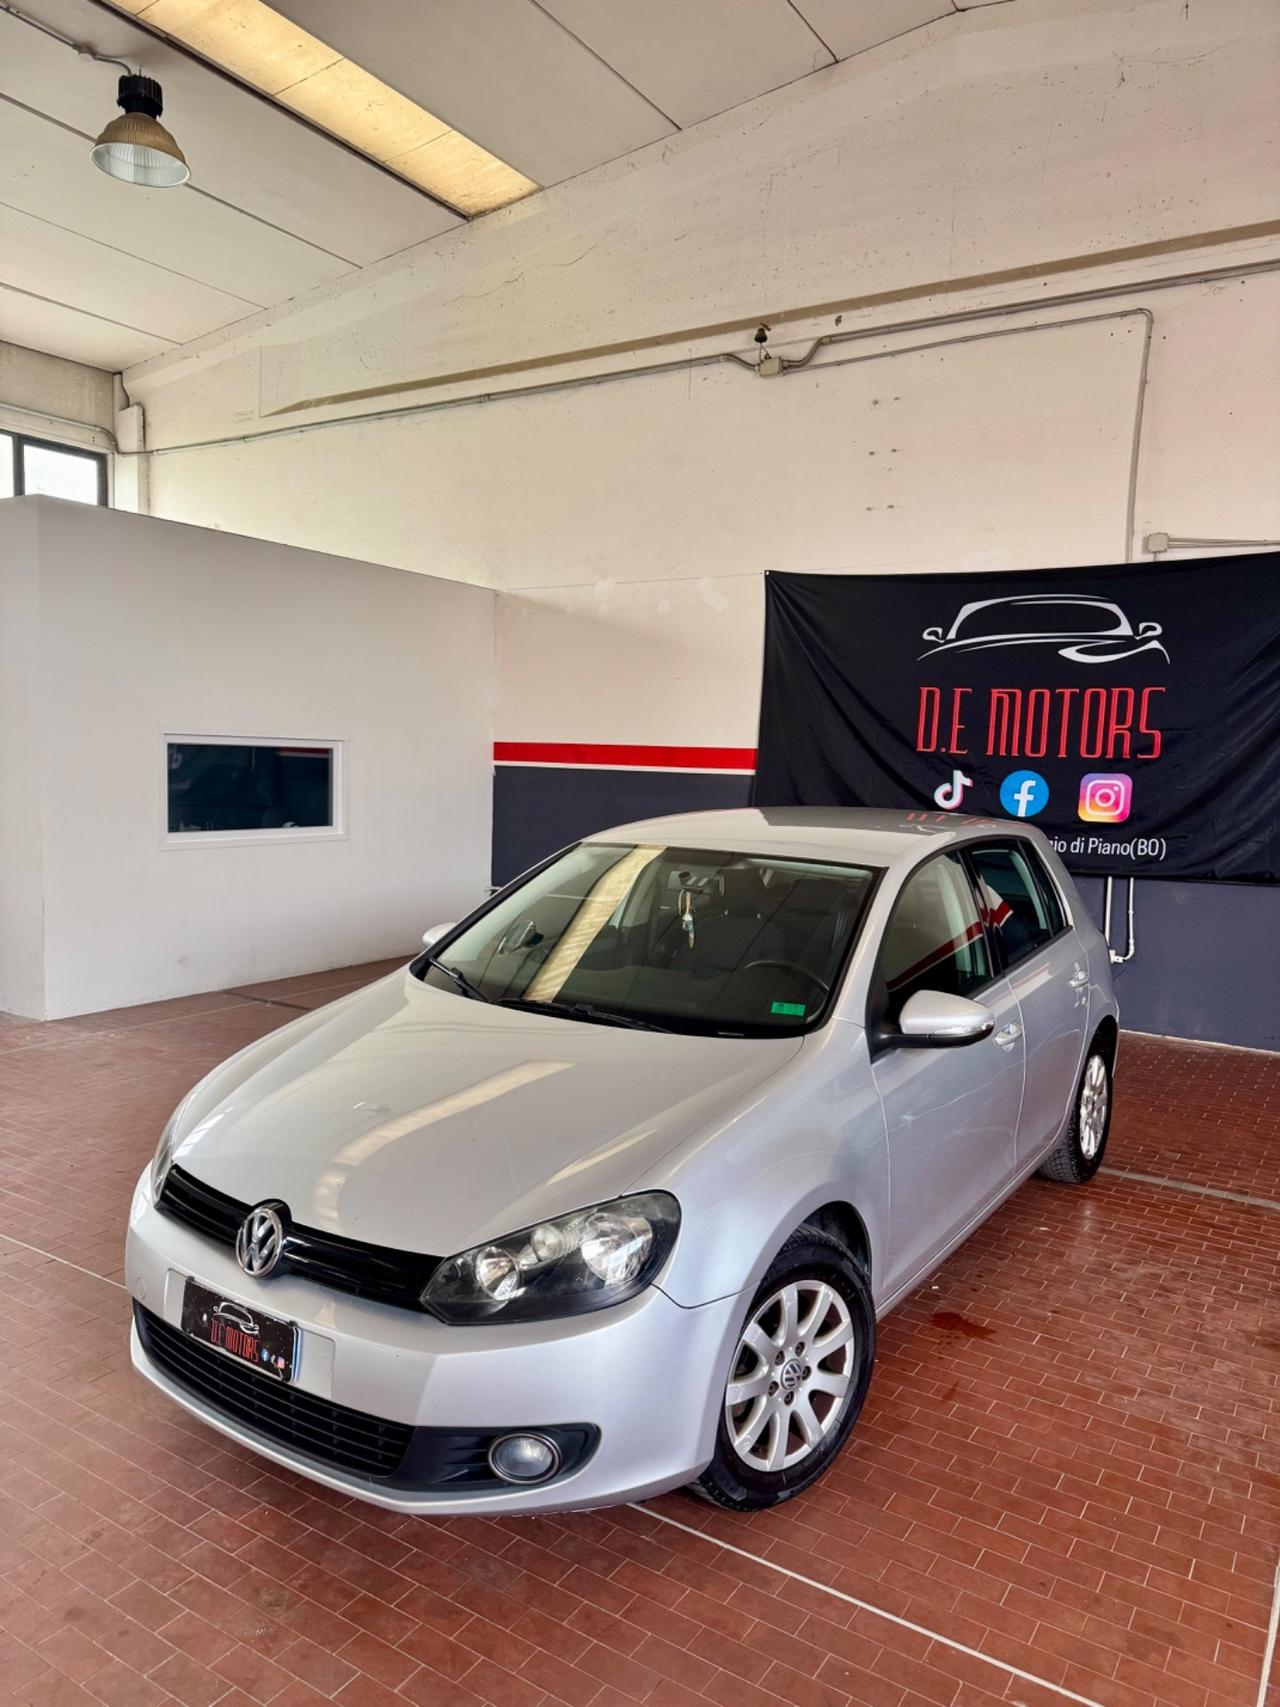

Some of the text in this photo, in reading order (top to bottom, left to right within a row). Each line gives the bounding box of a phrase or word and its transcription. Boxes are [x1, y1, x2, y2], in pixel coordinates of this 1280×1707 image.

[916, 686, 1167, 759] D.E MOTORS
[1048, 836, 1167, 861] io di Piano(BO)
